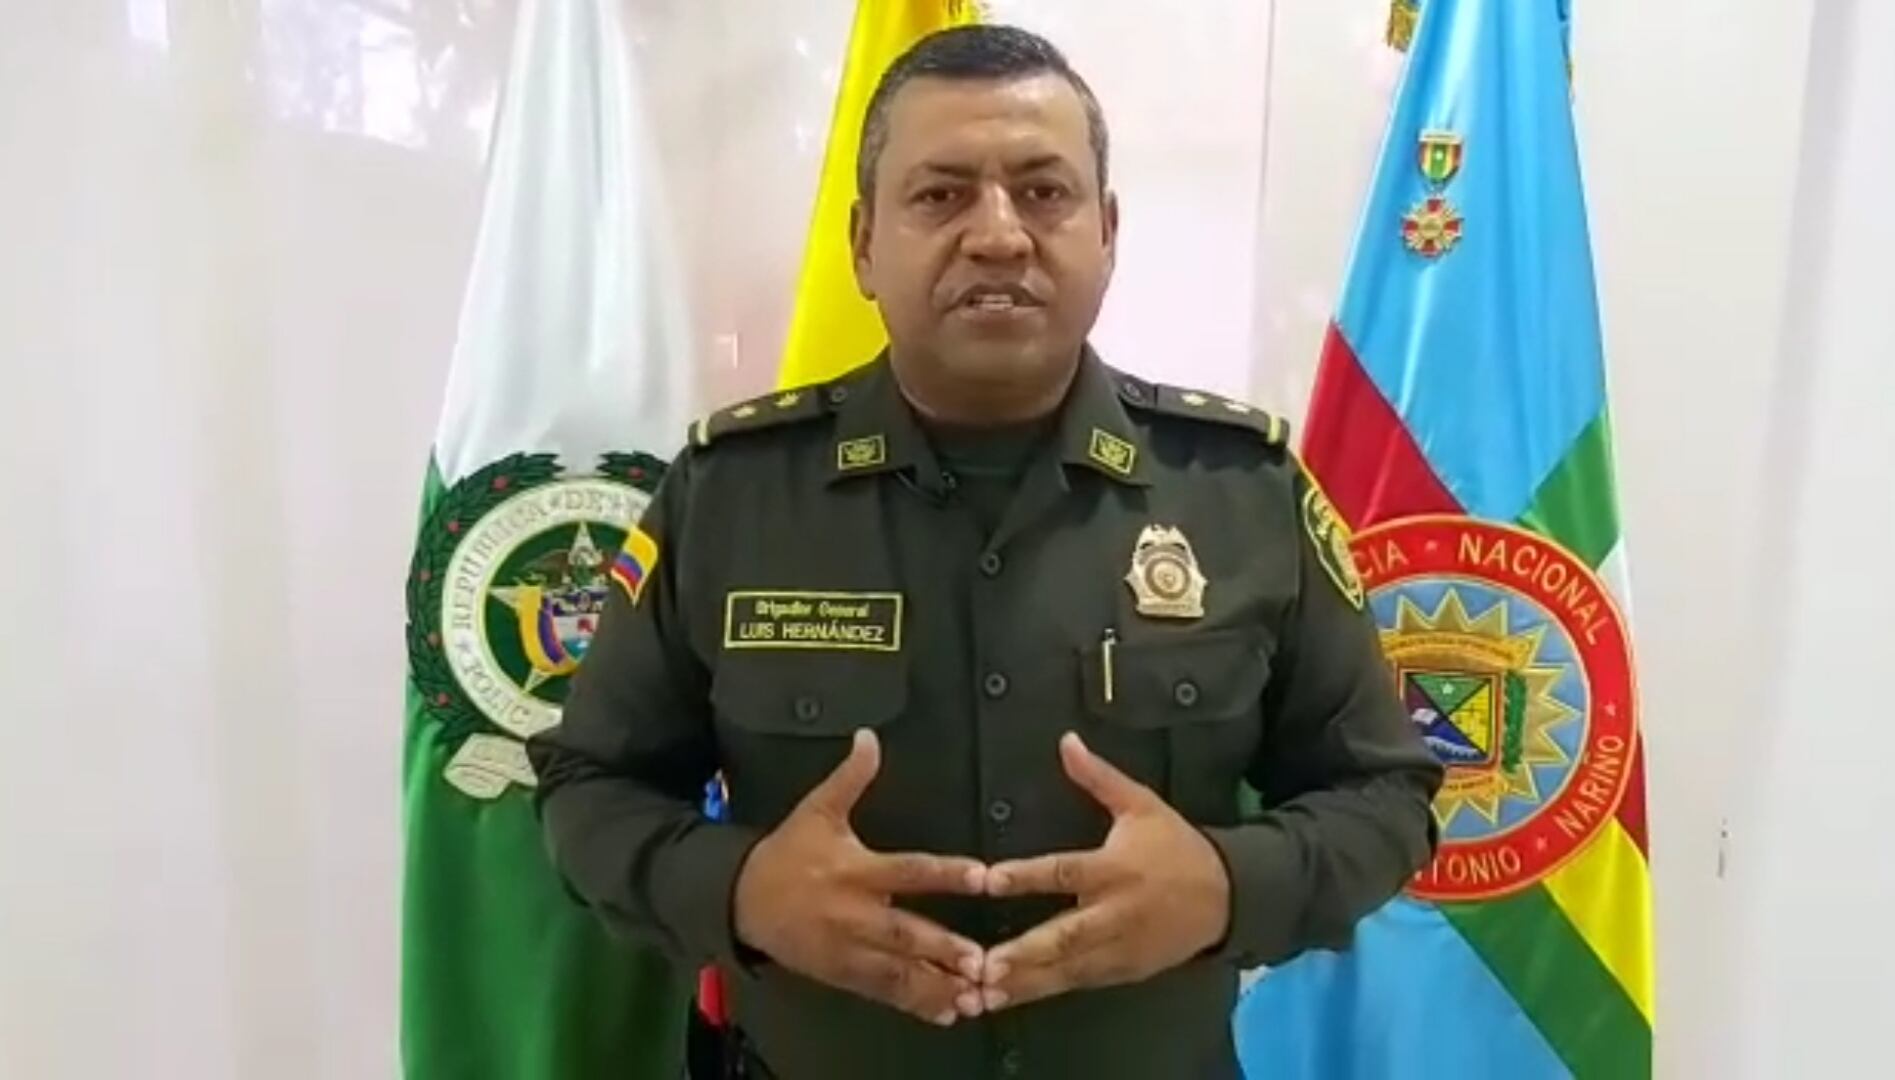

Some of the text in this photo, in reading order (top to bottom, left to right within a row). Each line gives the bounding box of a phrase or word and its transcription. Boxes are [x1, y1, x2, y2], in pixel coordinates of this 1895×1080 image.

[564, 488, 602, 511] DE
[1458, 532, 1609, 645] NACIONAL
[739, 619, 885, 642] LUIS HERNÁNDEZ
[1414, 735, 1625, 886] TONIO NARIÑO
